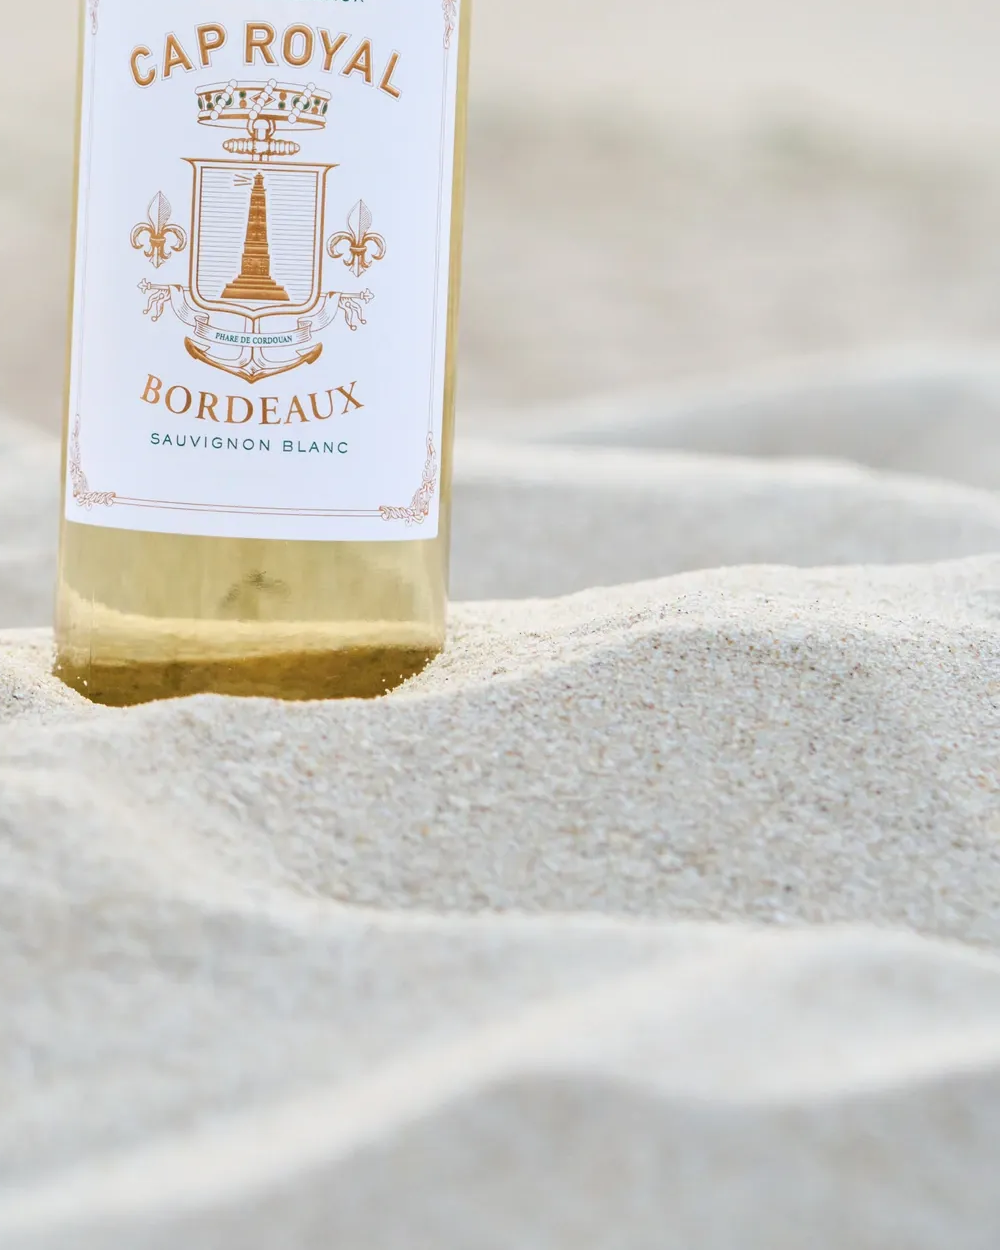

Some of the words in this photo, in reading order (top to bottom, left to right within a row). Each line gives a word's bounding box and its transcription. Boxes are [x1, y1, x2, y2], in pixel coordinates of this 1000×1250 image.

[129, 21, 229, 89] CAP
[243, 20, 403, 102] ROYAL
[215, 332, 239, 343] PHARE
[240, 336, 251, 344] DE
[252, 335, 293, 345] CORDOUAN
[139, 373, 365, 426] BORDEAUX
[150, 432, 271, 452] SAUVIGNON
[282, 440, 349, 455] BLANC
